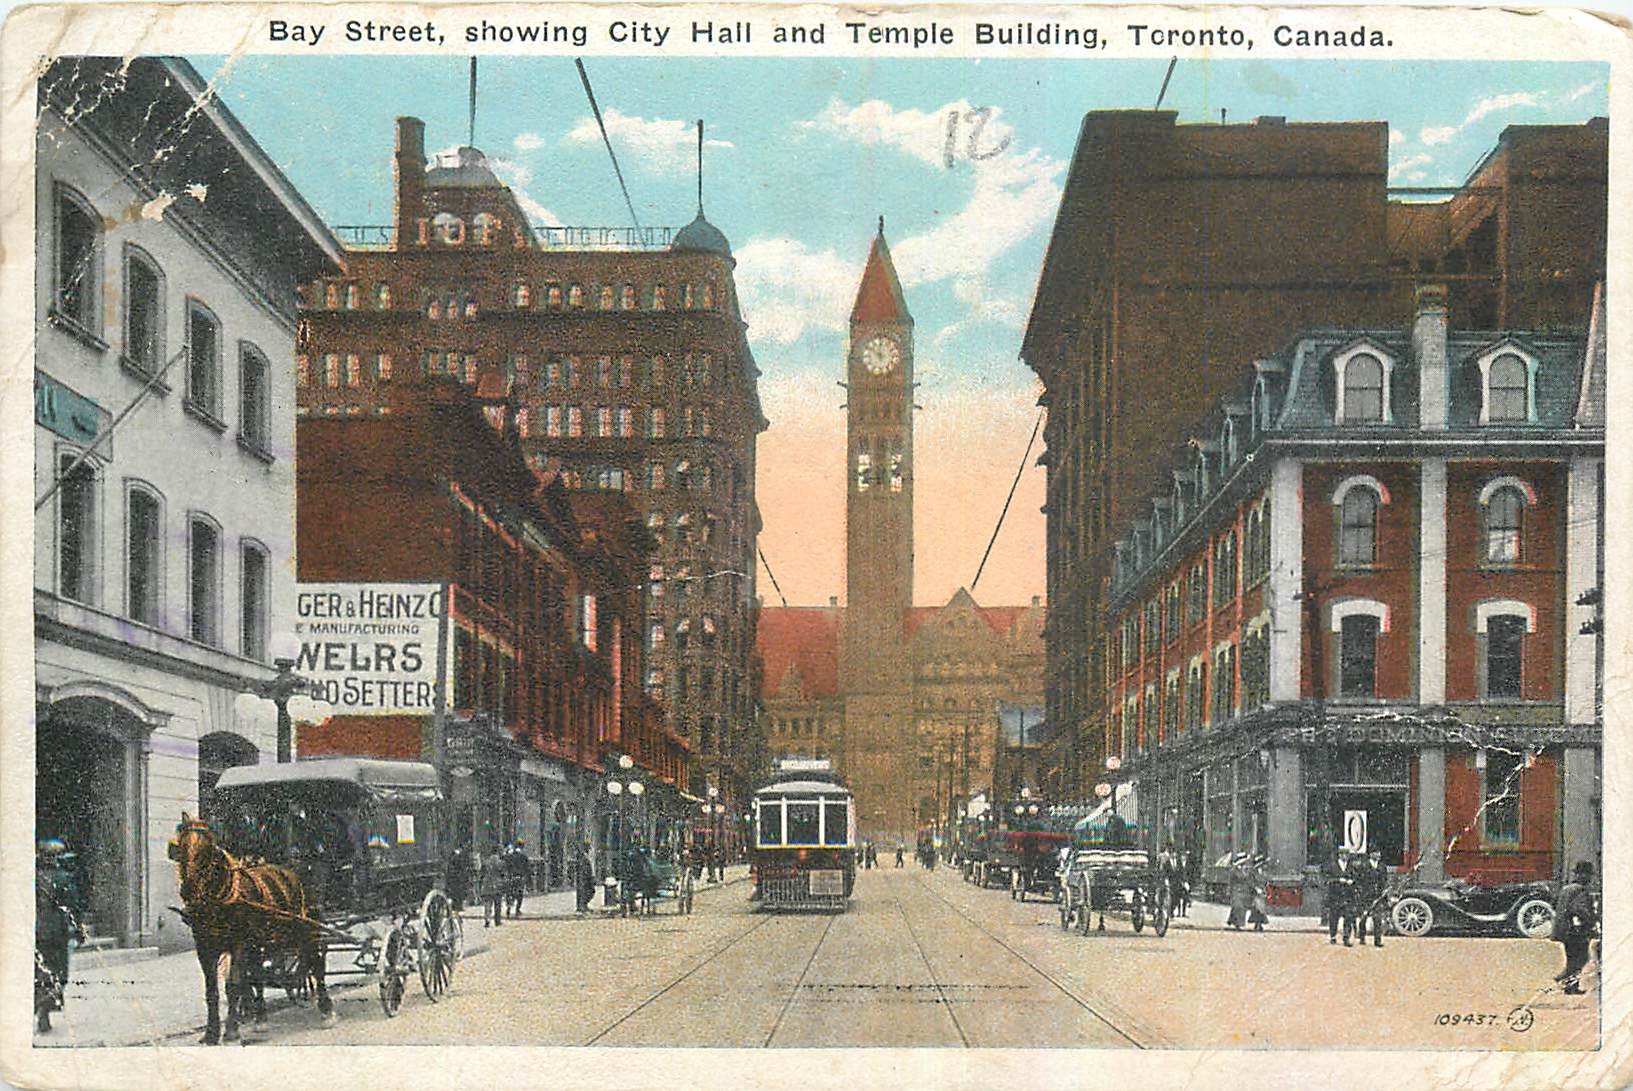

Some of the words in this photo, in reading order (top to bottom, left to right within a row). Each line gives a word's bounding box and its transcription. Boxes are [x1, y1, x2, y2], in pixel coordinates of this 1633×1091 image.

[298, 593, 342, 618] GER
[346, 600, 356, 618] &
[310, 623, 419, 635] MANUFACTURING
